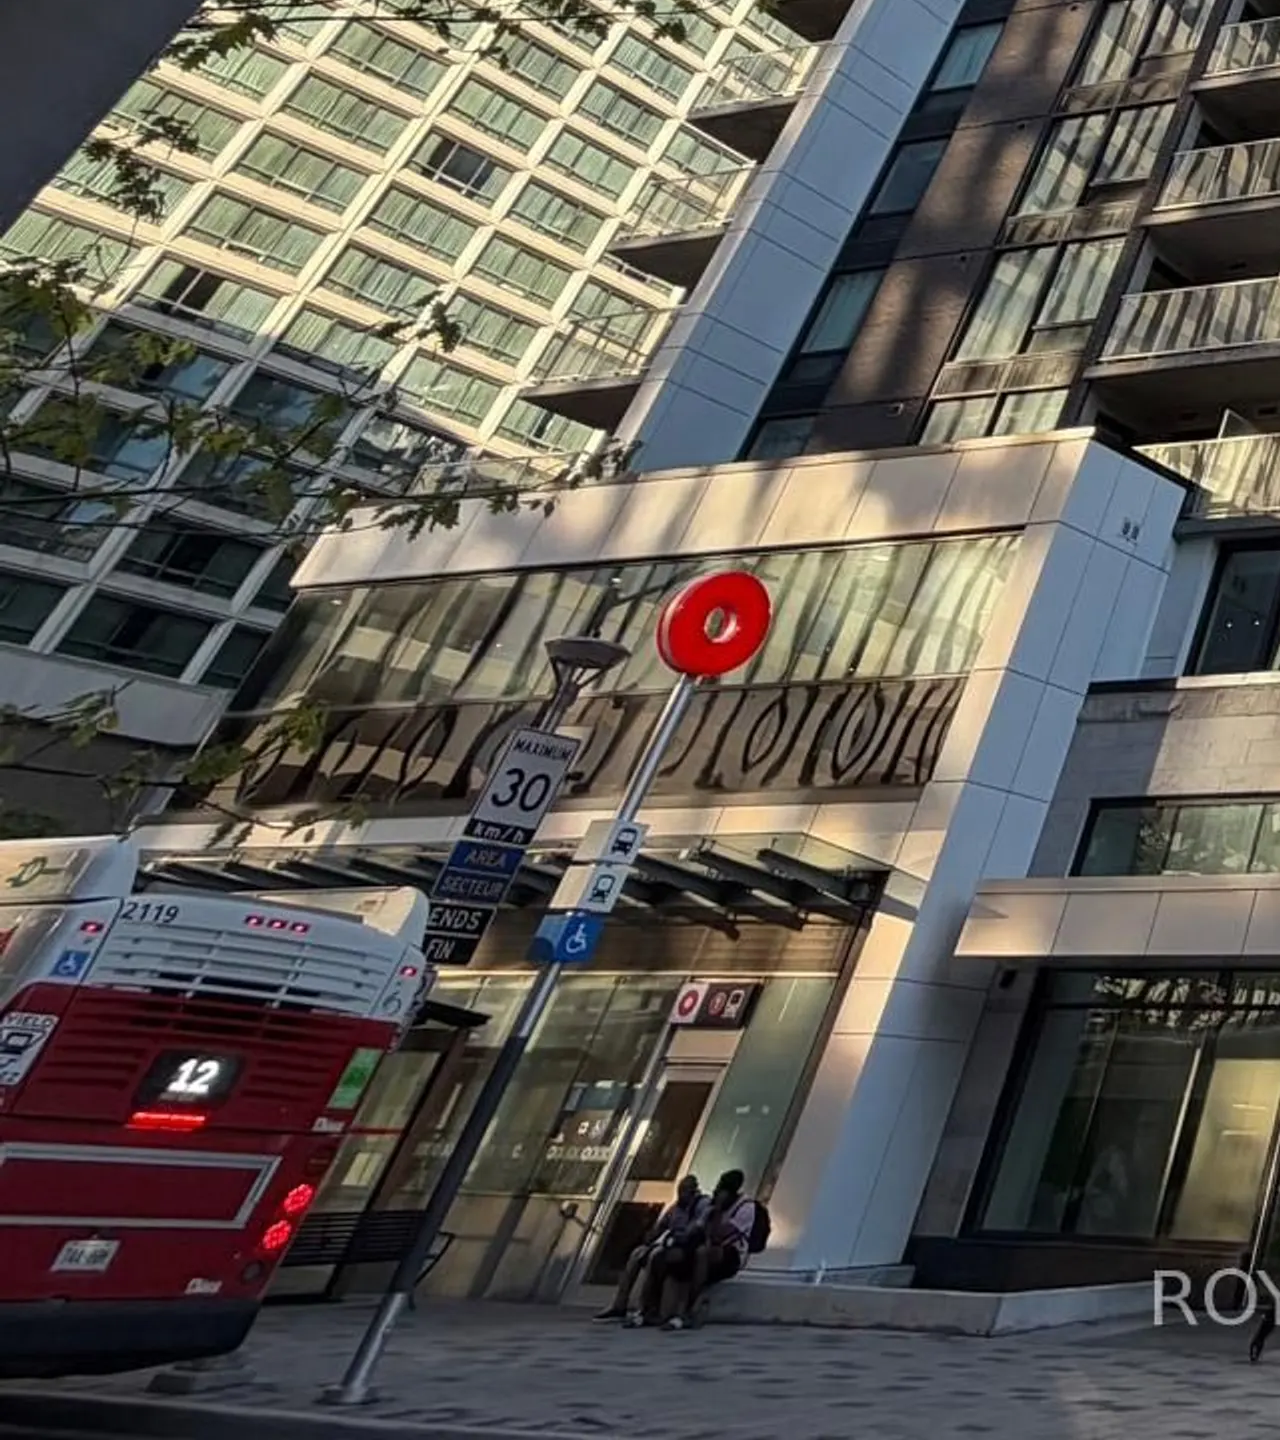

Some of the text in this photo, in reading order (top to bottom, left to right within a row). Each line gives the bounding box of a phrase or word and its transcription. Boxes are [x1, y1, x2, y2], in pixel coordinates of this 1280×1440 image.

[513, 738, 572, 760] MAXIMUM
[491, 768, 550, 811] 30
[473, 822, 525, 844] km/h
[464, 848, 507, 866] AREA
[440, 875, 504, 897] SECTEUR
[120, 902, 180, 923] 2119
[427, 907, 482, 930] ENDS
[426, 938, 455, 960] FIN
[6, 1014, 54, 1028] YIELD
[168, 1058, 221, 1094] 12
